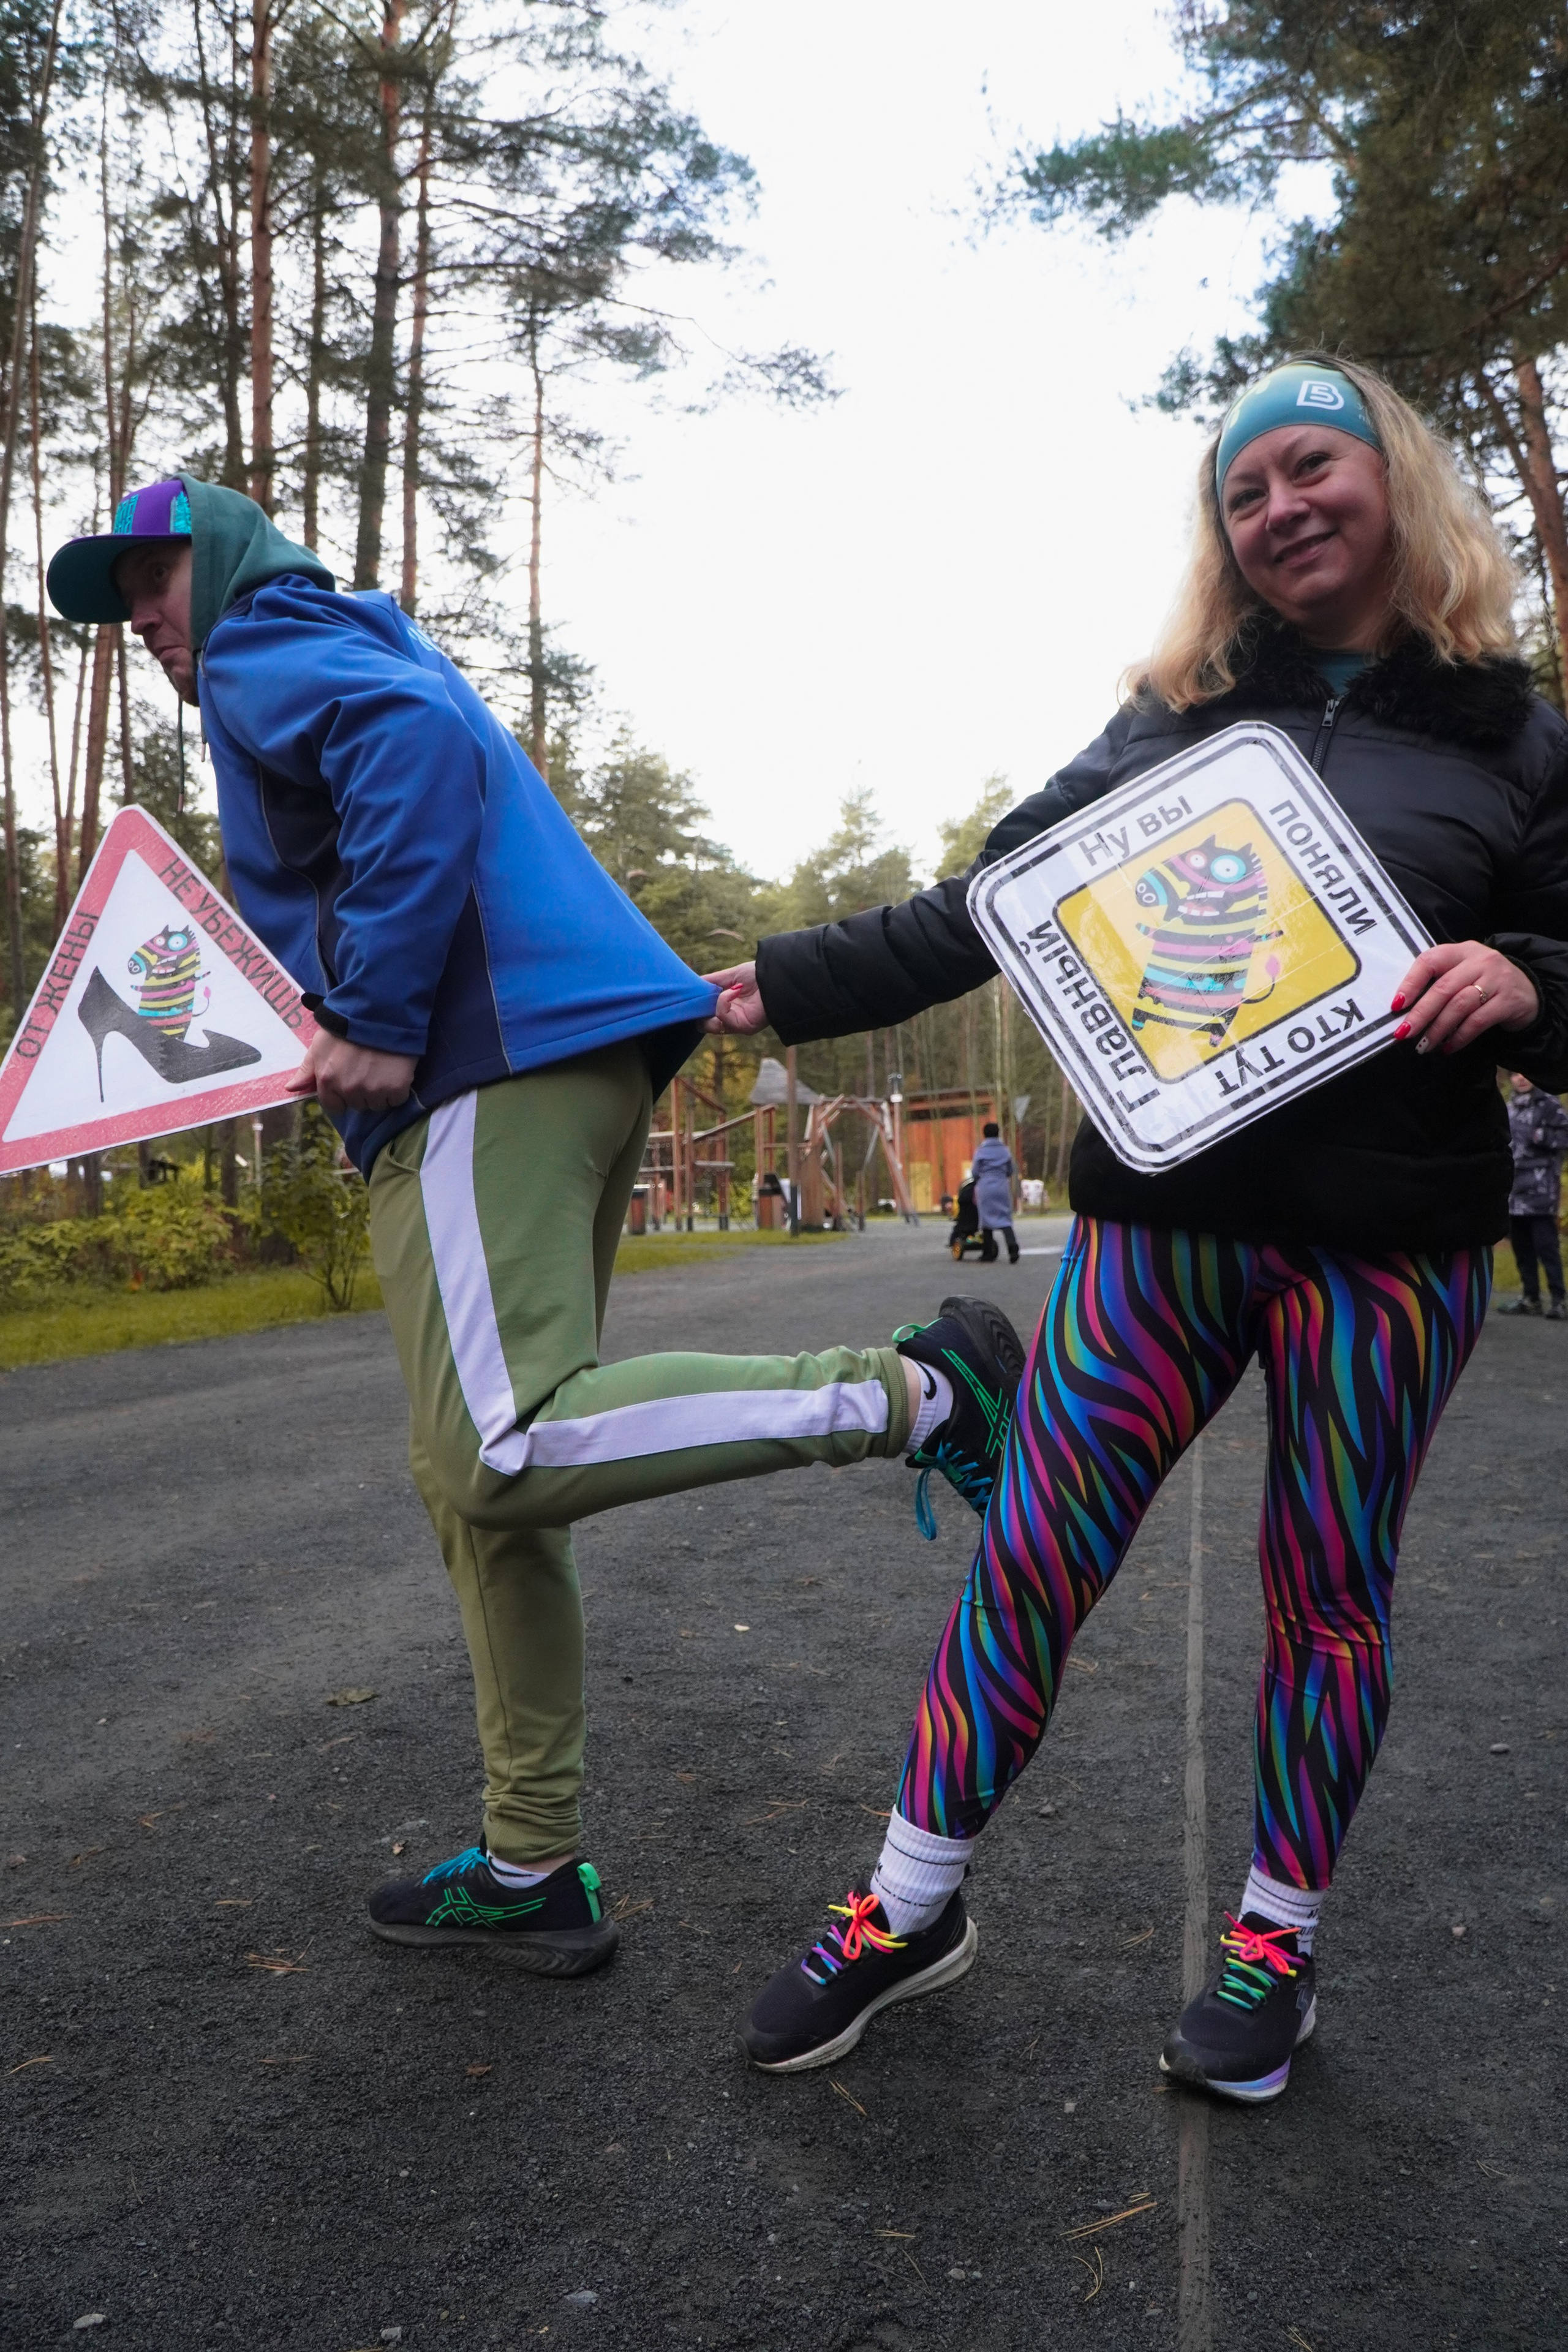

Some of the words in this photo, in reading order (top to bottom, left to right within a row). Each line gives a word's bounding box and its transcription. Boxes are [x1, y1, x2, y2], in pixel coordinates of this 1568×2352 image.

[1078, 827, 1131, 867] Ну
[16, 1016, 48, 1058] ОТ
[42, 911, 99, 1014] ЖЕНЫ
[1019, 919, 1161, 1114] Главный
